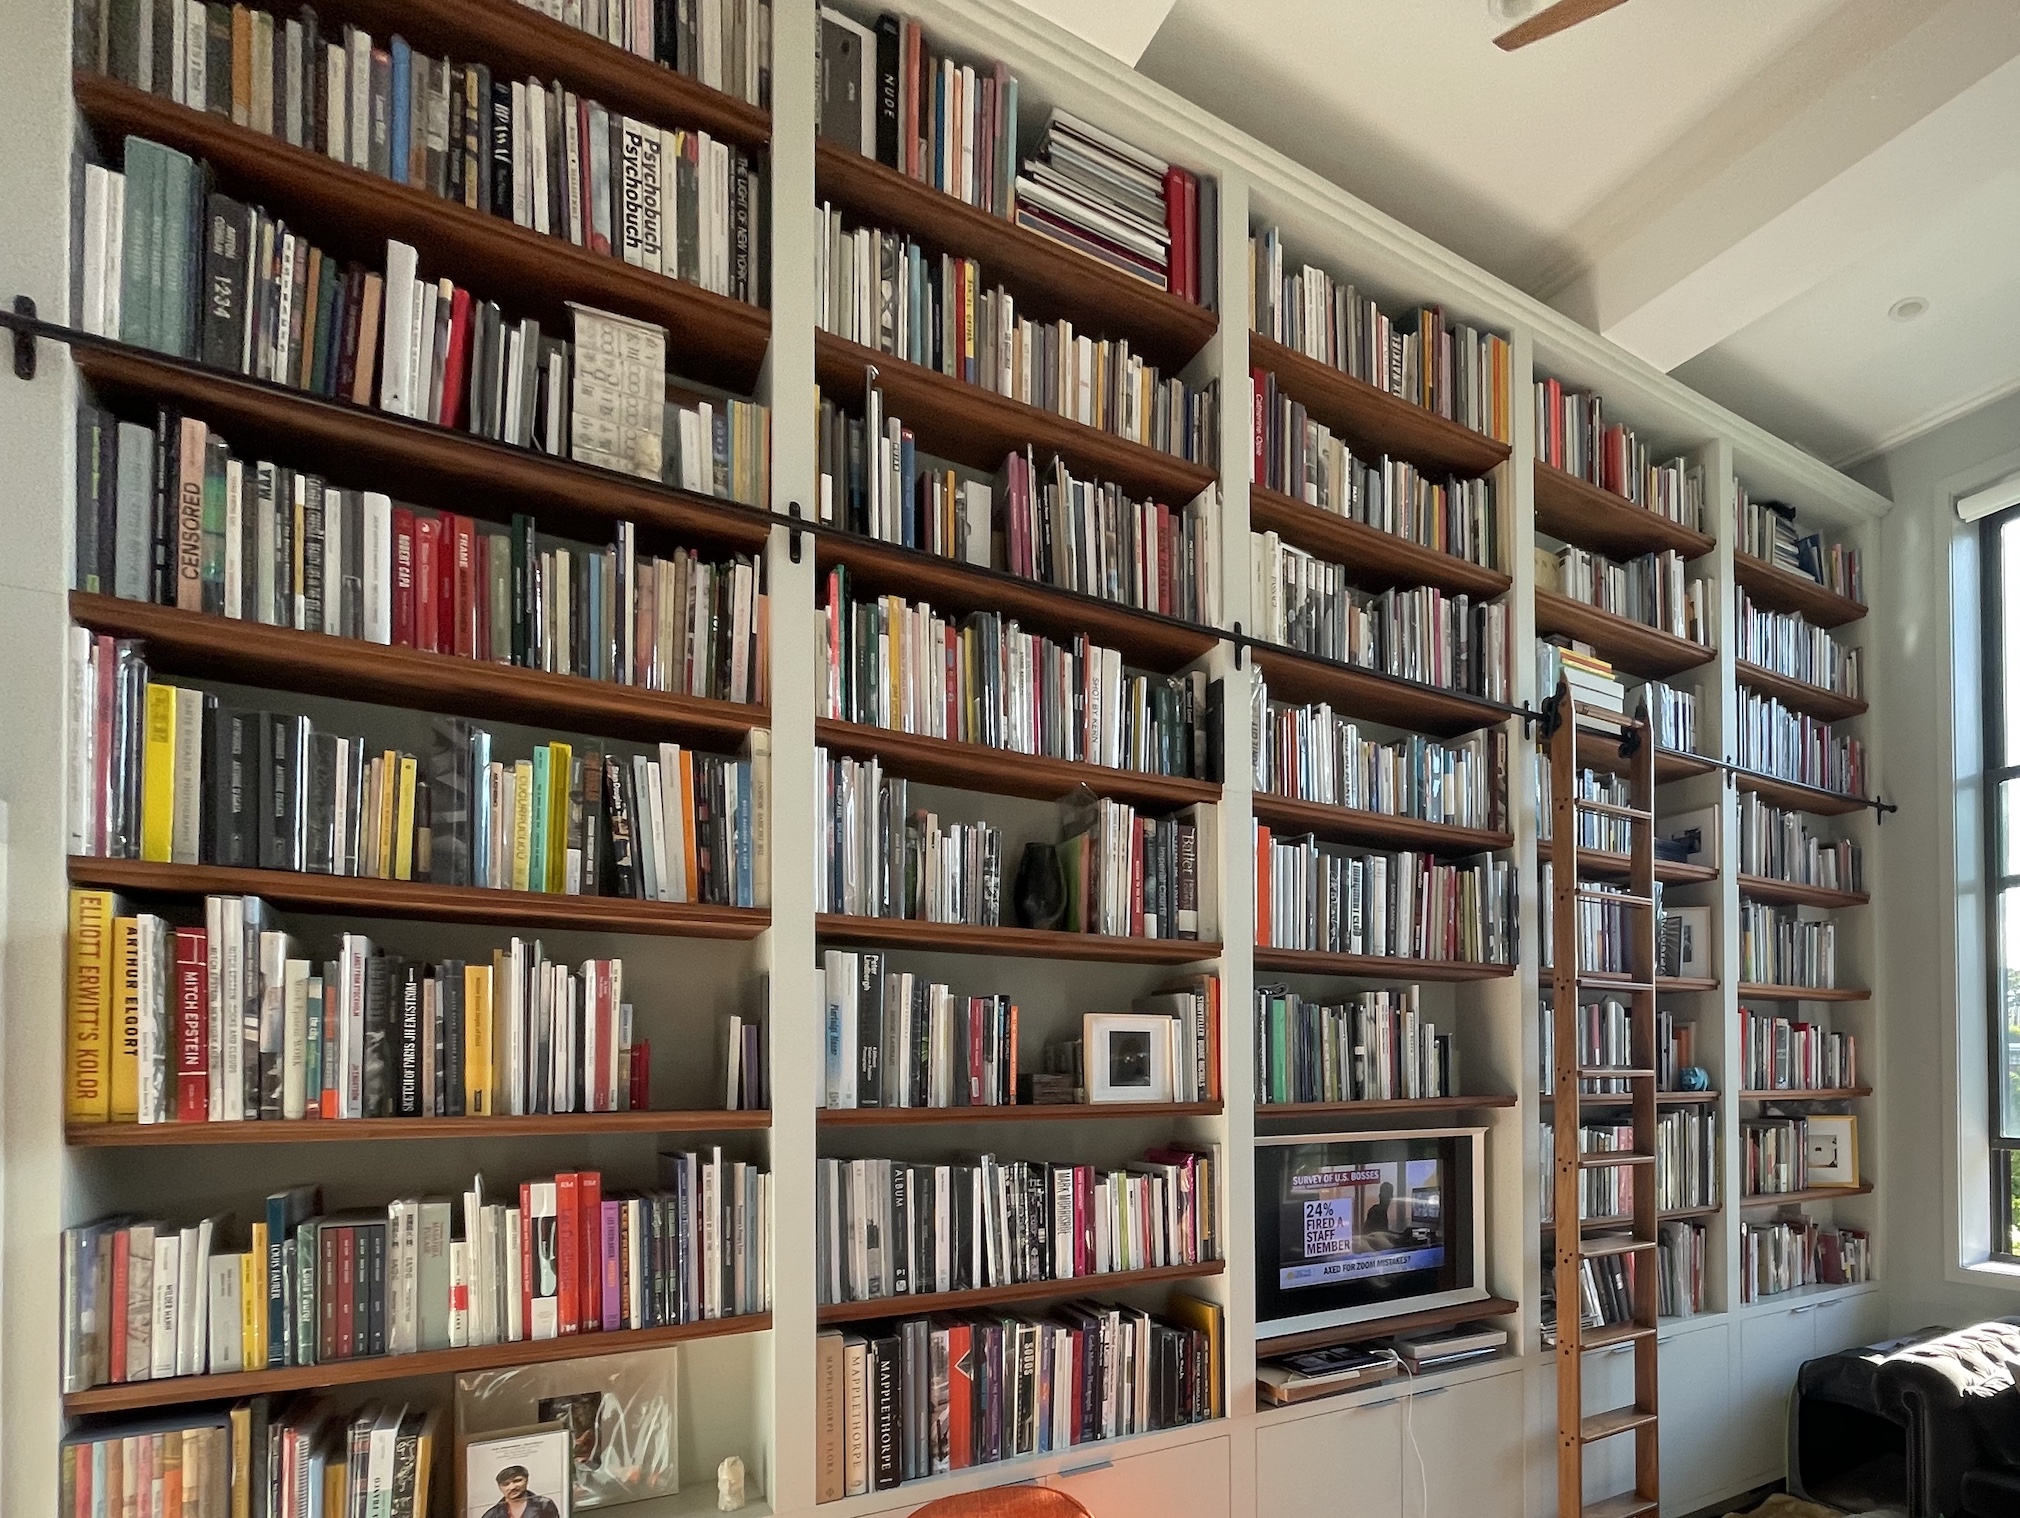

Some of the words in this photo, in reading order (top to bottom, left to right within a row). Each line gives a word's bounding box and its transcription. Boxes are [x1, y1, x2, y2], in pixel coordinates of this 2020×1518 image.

[885, 74, 896, 119] NUDE
[737, 158, 748, 176] THE
[623, 131, 644, 249] Psychobuch
[643, 138, 661, 256] Psychobuch
[737, 179, 748, 207] LIGHT
[737, 210, 747, 225] OF
[737, 226, 748, 250] NEW
[737, 254, 748, 282] YORK
[1392, 336, 1402, 381] NATKIEL
[1255, 393, 1264, 434] Catherine
[1255, 435, 1263, 457] Opie
[181, 482, 200, 581] CENSORED
[399, 534, 411, 564] ROBERT
[459, 533, 469, 568] FRAME
[399, 566, 411, 589] CAPA
[1091, 677, 1100, 700] SHOT
[1092, 704, 1099, 716] BY
[1091, 718, 1100, 743] KERN
[1251, 721, 1259, 741] CITY
[611, 766, 622, 783] Stan
[613, 782, 624, 810] Douglas
[1157, 846, 1169, 882] Imperial
[1181, 828, 1196, 875] Ballet
[1158, 885, 1168, 917] Courts
[77, 896, 102, 960] ELLIOTT
[125, 926, 139, 989] ARTHUR
[870, 955, 881, 975] Peter
[861, 954, 873, 991] Lindbergh
[76, 965, 101, 1042] ERWITT'S
[184, 971, 199, 1010] MITCH
[124, 996, 138, 1057] ELGORT
[1196, 995, 1205, 1037] STORYTELLER
[183, 1013, 199, 1065] EPSTEIN
[307, 1027, 320, 1041] city
[402, 1028, 416, 1041] JH
[292, 1040, 304, 1067] WORK
[402, 1042, 416, 1068] PARIS
[74, 1049, 99, 1100] KOLOR
[1197, 1060, 1206, 1087] MICHALS
[402, 1079, 415, 1112] SKETCH
[894, 1169, 904, 1208] ALBUM
[1057, 1172, 1071, 1193] MARK
[1292, 1174, 1323, 1187] SURVEY
[1323, 1173, 1333, 1183] OF
[1334, 1171, 1349, 1183] U.S.
[1350, 1170, 1380, 1182] BOSSES
[621, 1206, 630, 1227] LEE
[1057, 1193, 1071, 1236] MORRISROE
[1306, 1202, 1334, 1218] 24%
[1306, 1218, 1335, 1231] FIRED
[1337, 1216, 1345, 1228] A
[1306, 1230, 1336, 1243] STAFF
[1306, 1240, 1351, 1256] MEMBER
[270, 1243, 282, 1268] LOUIS
[1323, 1264, 1342, 1276] AXED
[1342, 1263, 1356, 1273] FOR
[1356, 1260, 1376, 1272] ZOOM
[269, 1268, 282, 1300] FAURER
[301, 1267, 314, 1292] Louis
[621, 1230, 630, 1319] FRIEDLANDER
[163, 1284, 175, 1309] WILDER
[163, 1310, 174, 1331] MANN
[824, 1354, 834, 1434] MAPPLETHORPE
[851, 1355, 862, 1469] MAPPLETHORPE
[880, 1359, 891, 1471] MAPPLETHORPE
[825, 1442, 835, 1475] FLORA
